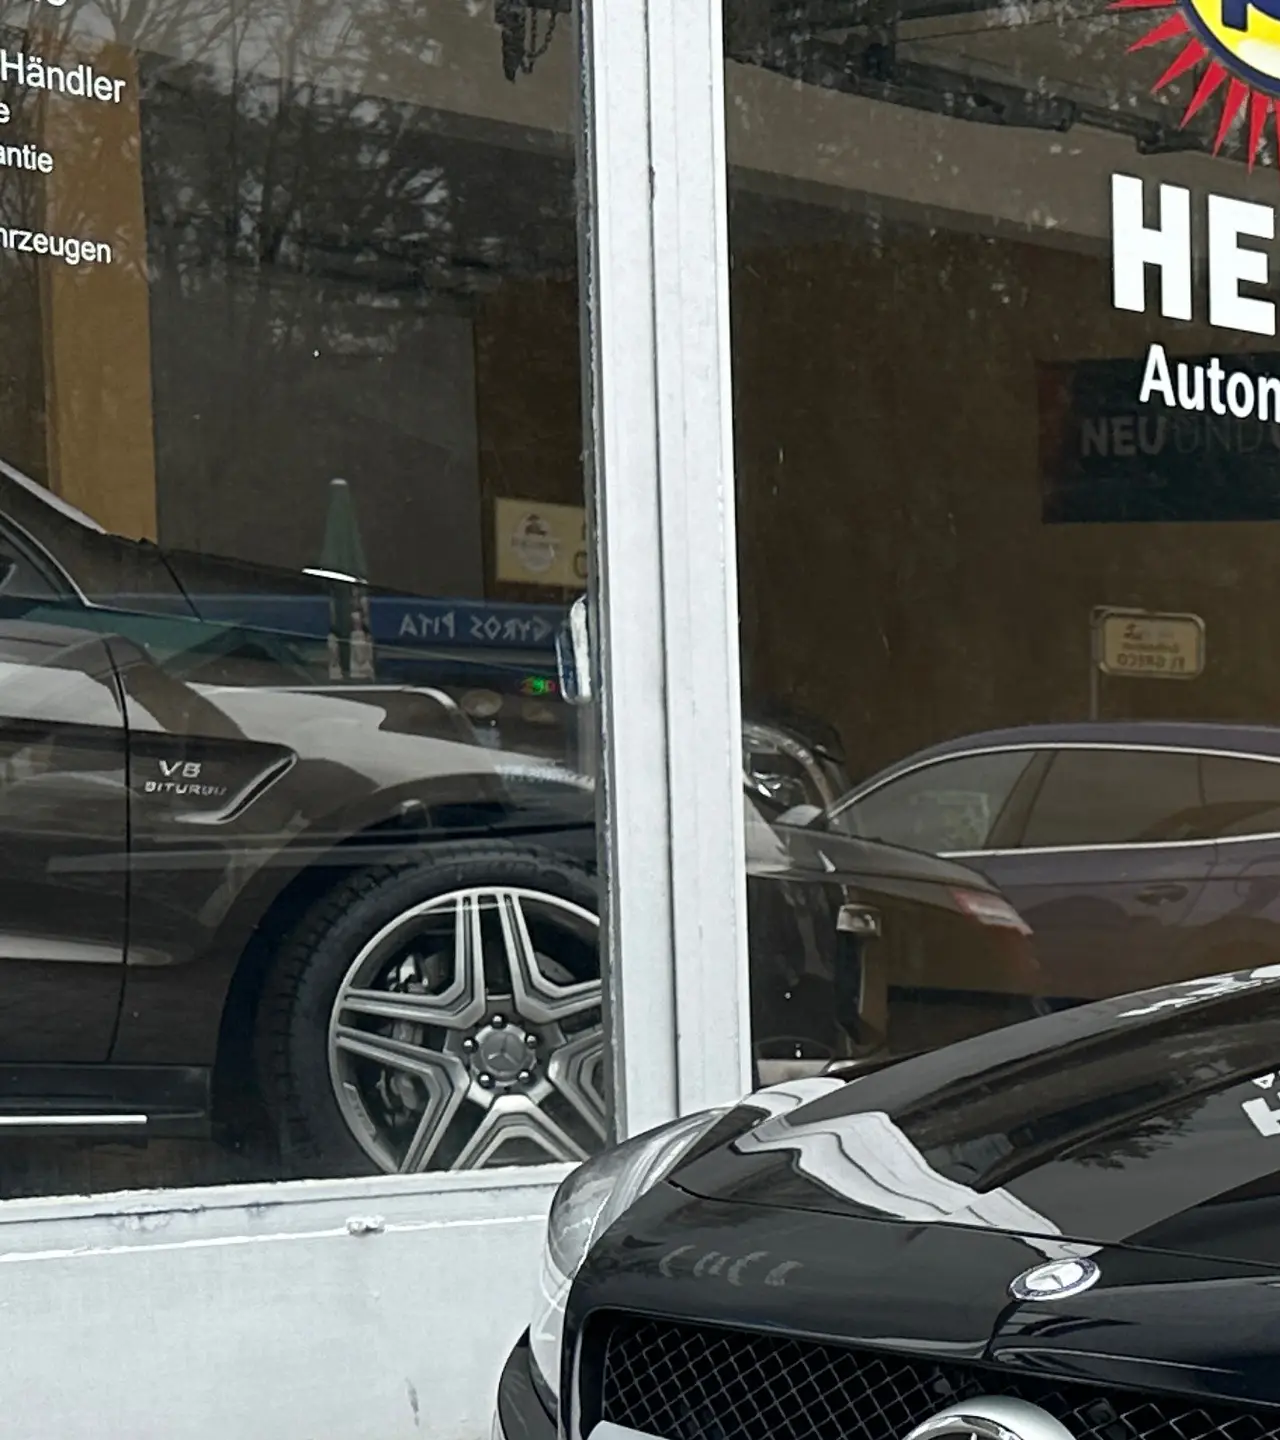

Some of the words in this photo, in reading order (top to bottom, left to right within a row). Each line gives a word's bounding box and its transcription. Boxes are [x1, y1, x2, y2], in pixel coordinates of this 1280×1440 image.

[0, 49, 127, 103] Händler
[1080, 415, 1168, 458] NEU
[158, 760, 201, 778] V8
